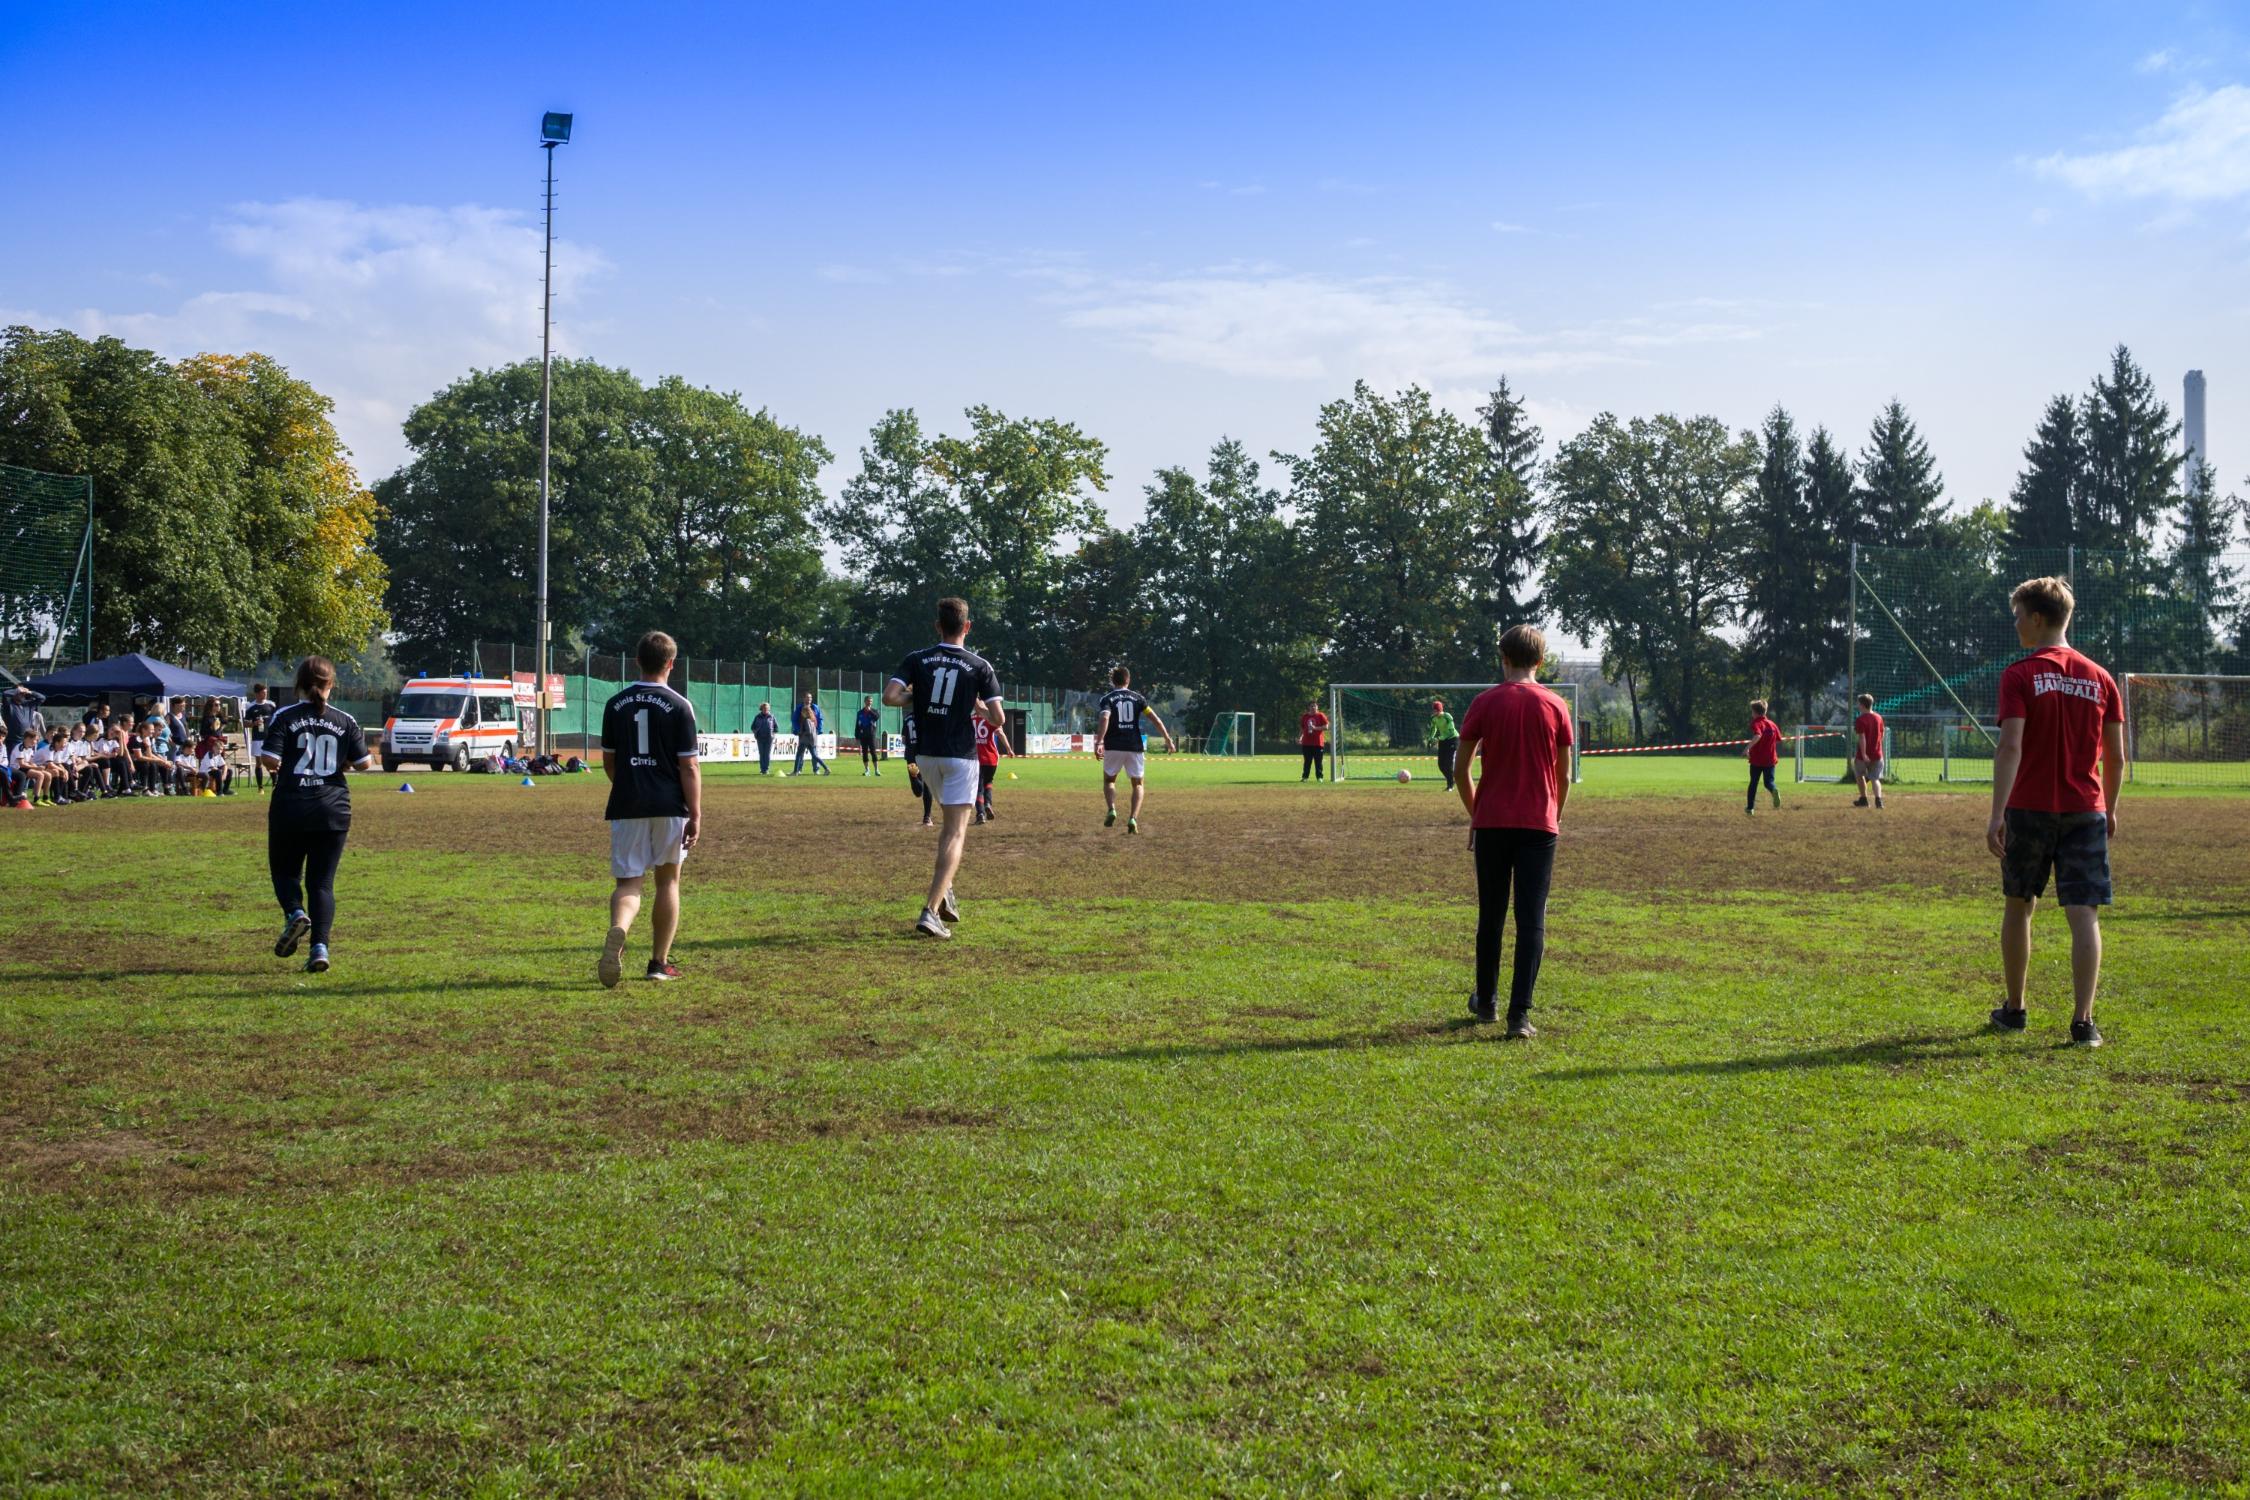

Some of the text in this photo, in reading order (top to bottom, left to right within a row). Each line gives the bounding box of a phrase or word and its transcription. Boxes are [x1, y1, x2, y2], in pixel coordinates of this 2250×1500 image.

[931, 667, 959, 705] 11
[2034, 679, 2101, 704] HANDBALL
[613, 696, 634, 712] Minis
[928, 705, 948, 715] Andi
[1115, 700, 1134, 722] 10
[634, 708, 649, 754] 1
[972, 719, 989, 739] 16
[293, 731, 338, 776] 20
[630, 756, 657, 766] Chris
